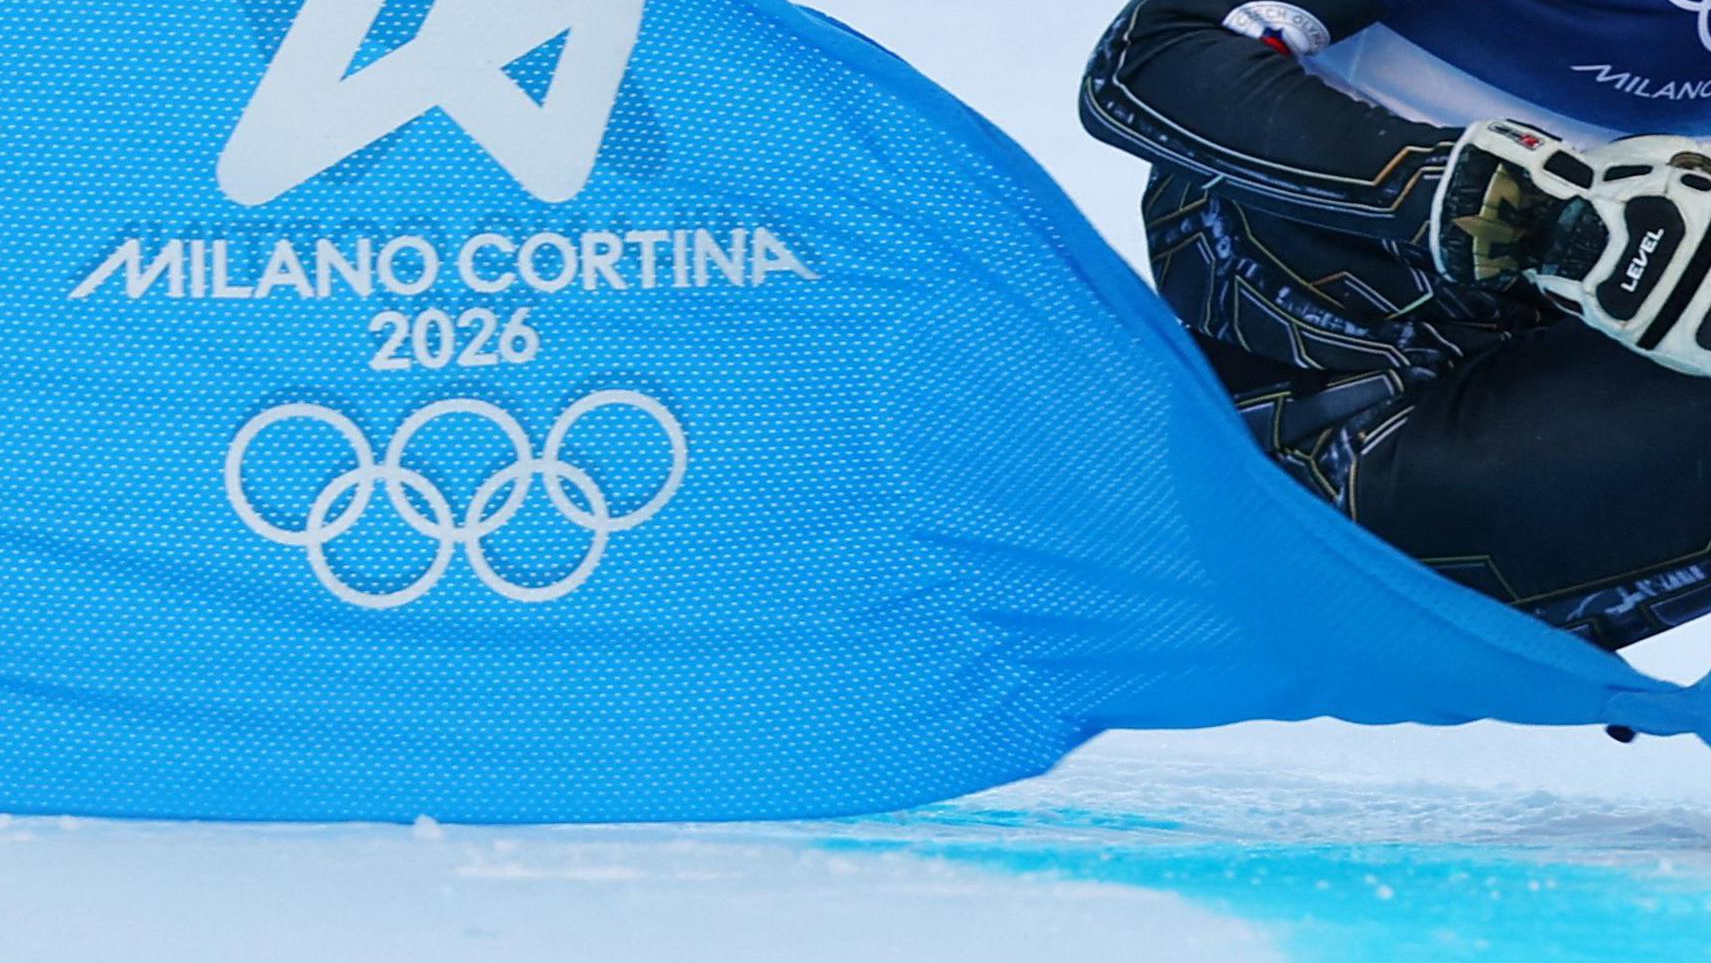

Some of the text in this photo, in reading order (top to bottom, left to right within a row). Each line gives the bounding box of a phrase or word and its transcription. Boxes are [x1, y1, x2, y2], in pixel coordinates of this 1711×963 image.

[67, 226, 823, 300] MILANO CORTINA
[1620, 227, 1664, 294] LEVEL
[367, 307, 541, 372] 2026
